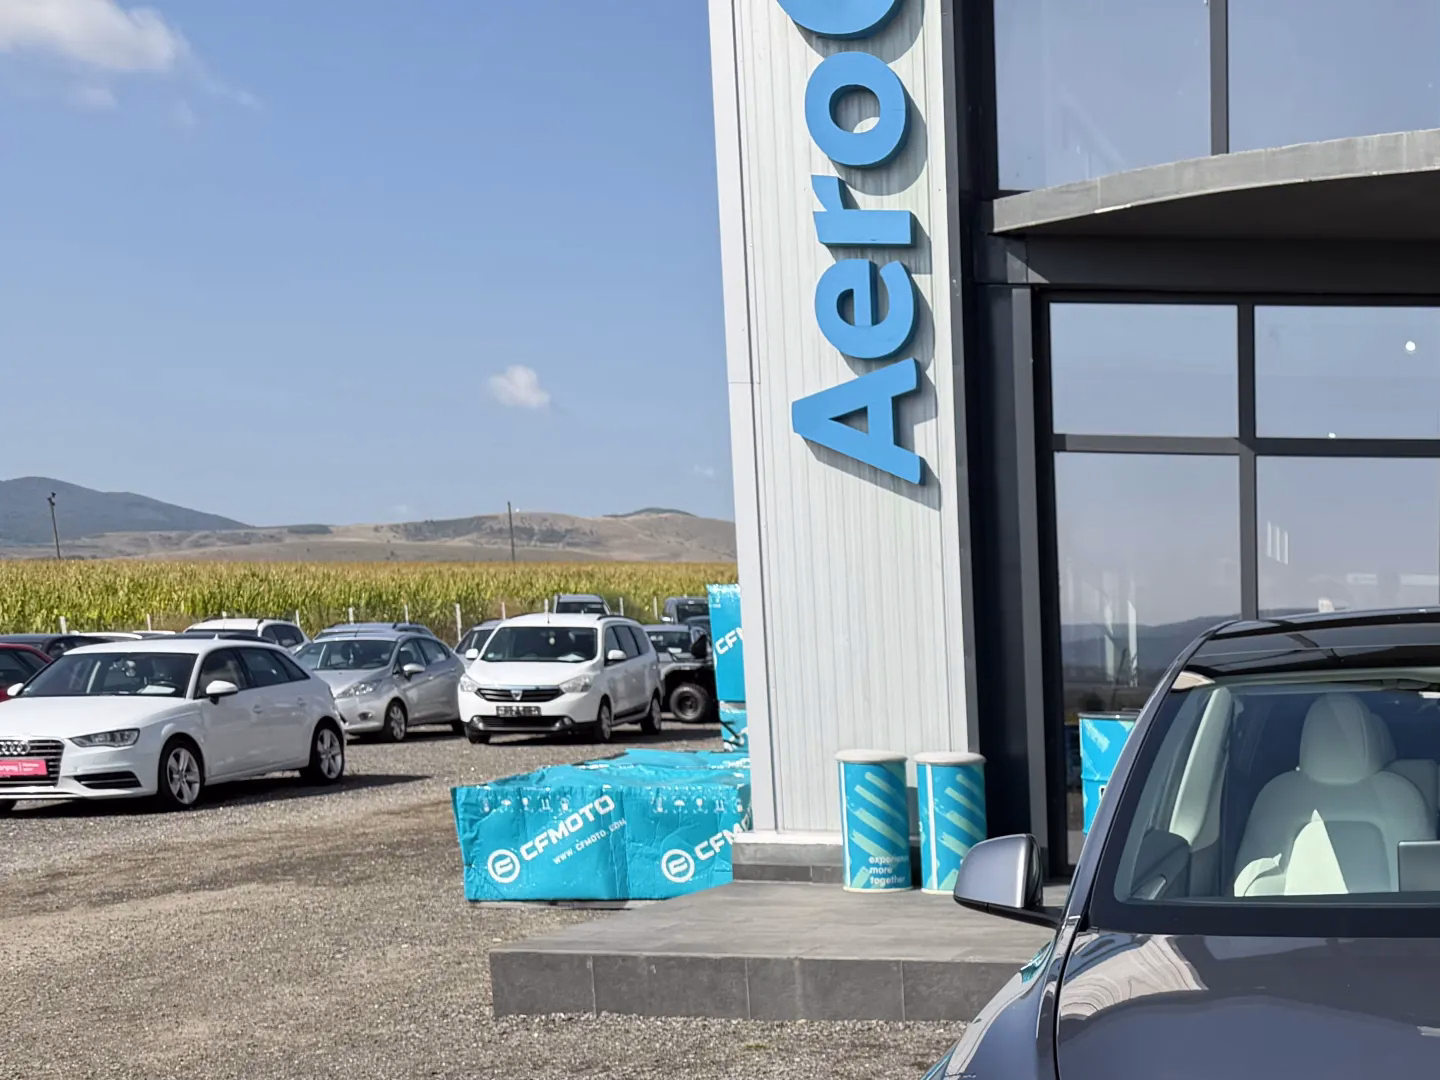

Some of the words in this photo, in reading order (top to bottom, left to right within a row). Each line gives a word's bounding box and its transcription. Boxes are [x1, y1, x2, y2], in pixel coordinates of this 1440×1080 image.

[776, 0, 925, 486] Aero
[519, 794, 615, 861] CFMOTO
[869, 866, 893, 875] more
